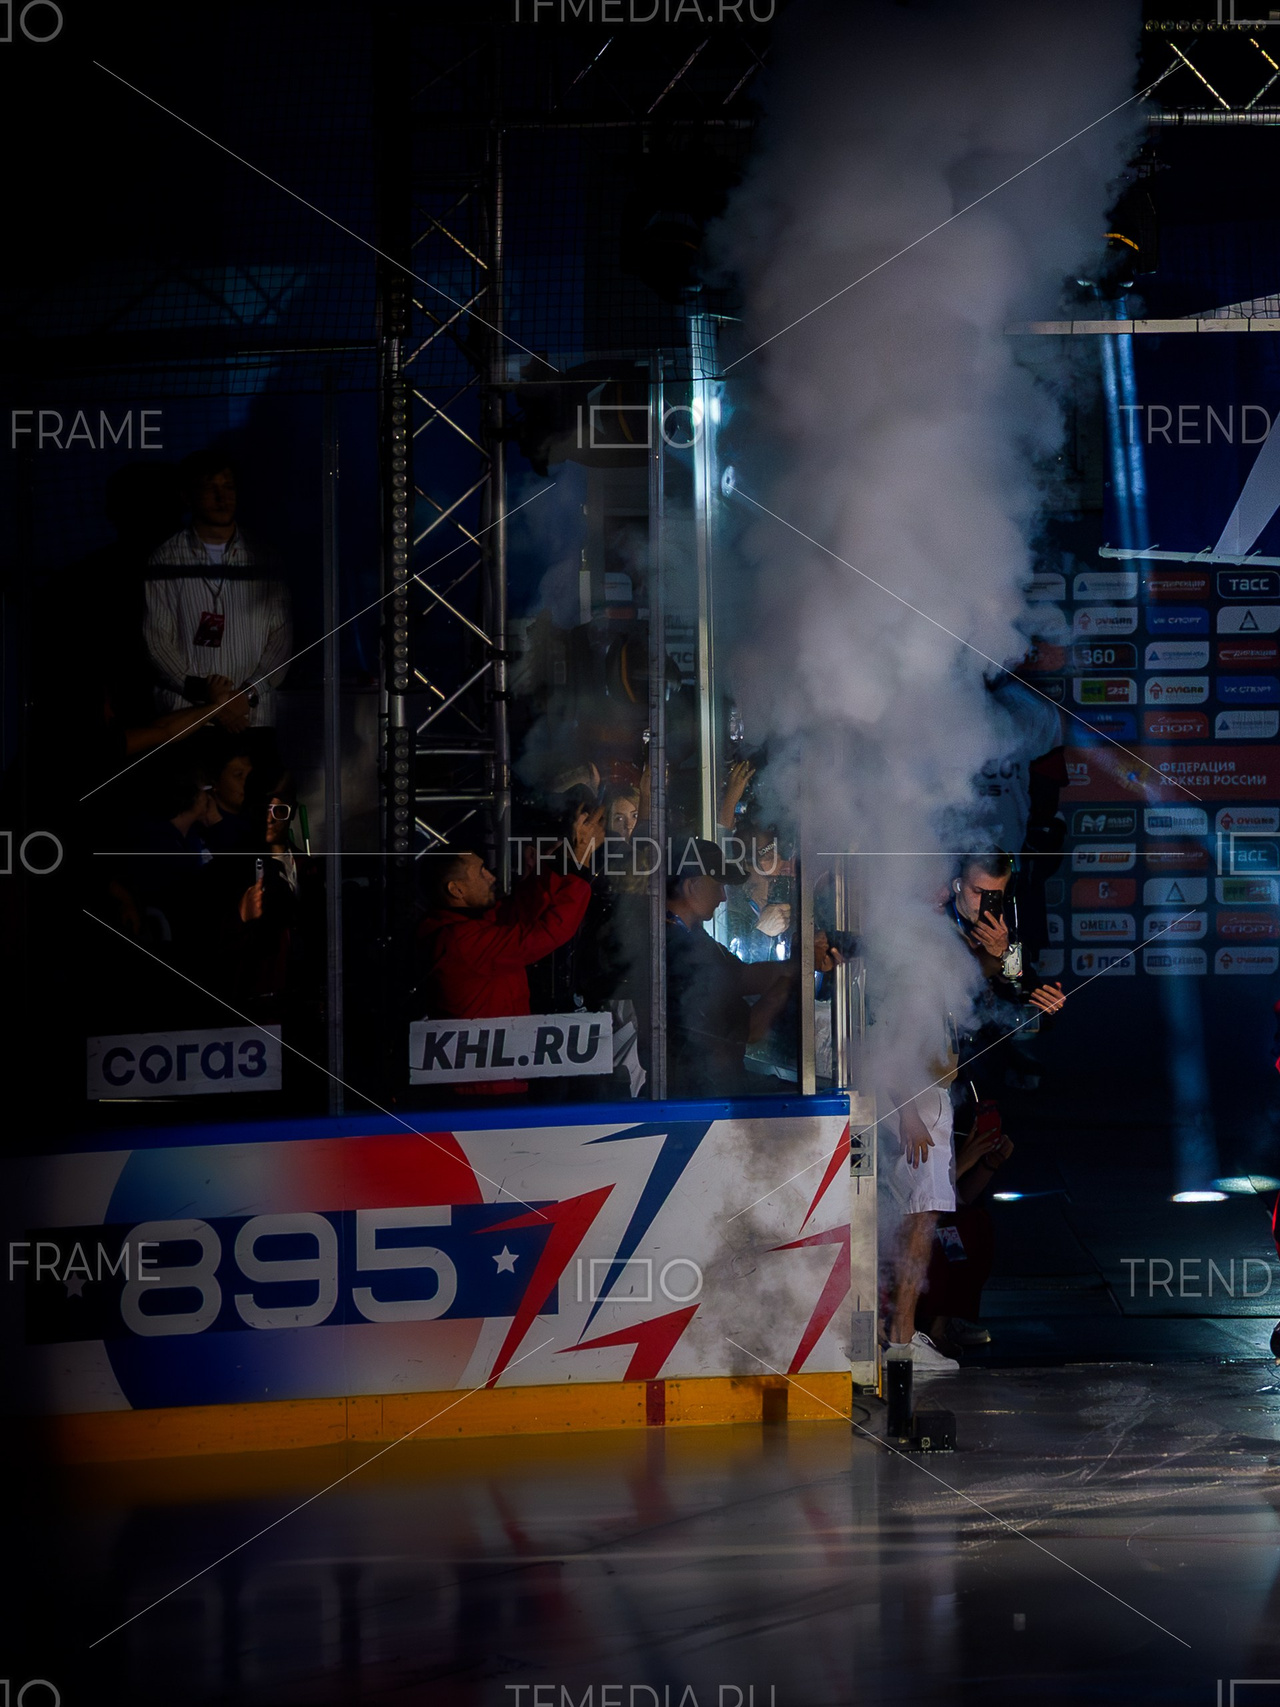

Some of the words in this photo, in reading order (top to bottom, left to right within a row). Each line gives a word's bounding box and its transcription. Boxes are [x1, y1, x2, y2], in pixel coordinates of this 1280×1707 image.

[1082, 649, 1115, 664] 360
[1159, 761, 1236, 773] ФЕДЕРАЦИЯ
[1159, 774, 1211, 786] ХОККЕЯ
[1213, 774, 1267, 786] РОССИИ
[1098, 955, 1131, 969] ПСБ
[421, 1024, 601, 1071] KHL.RU
[119, 1204, 458, 1337] 895
